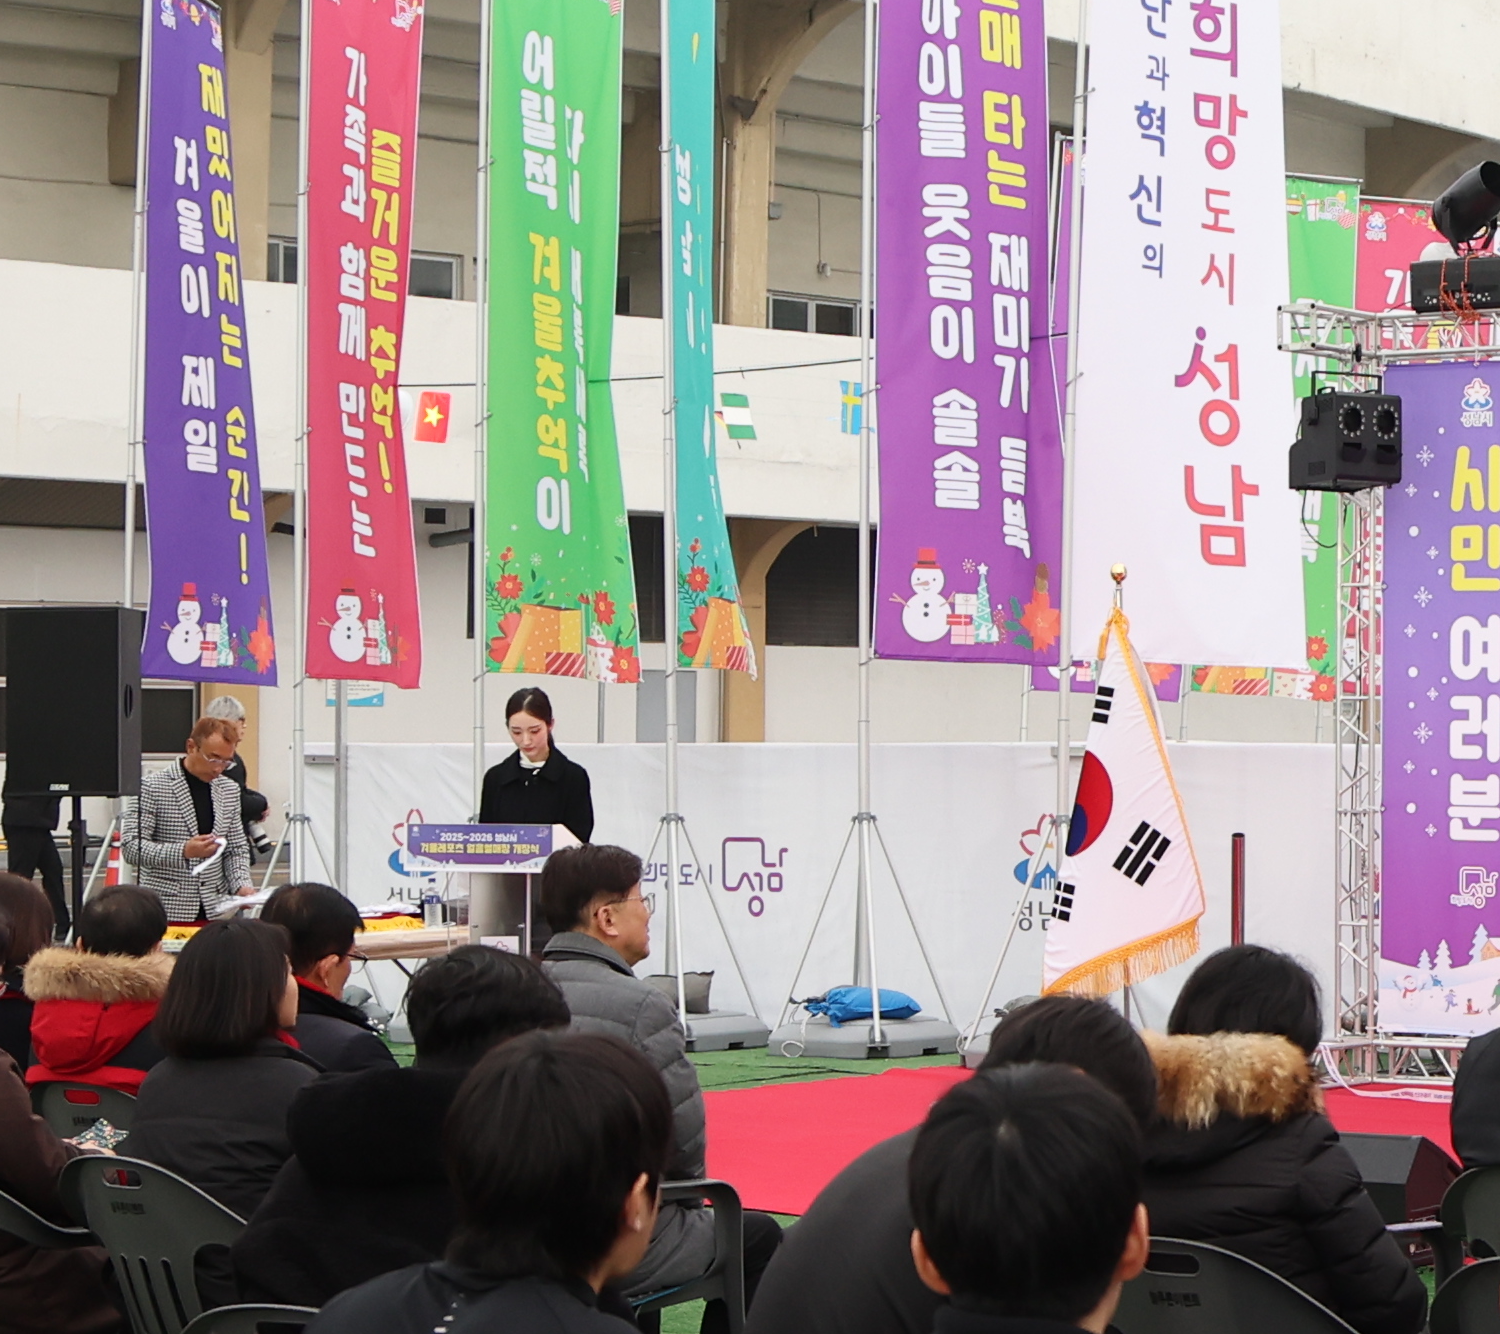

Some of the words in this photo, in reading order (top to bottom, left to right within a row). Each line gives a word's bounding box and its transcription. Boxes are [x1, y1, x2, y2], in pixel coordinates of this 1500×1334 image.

[341, 46, 368, 224] 가족과
[520, 29, 558, 212] 어릴적
[982, 89, 1027, 209] 타는
[173, 135, 211, 318] 겨울이
[198, 62, 242, 369] 재밌어지는
[338, 241, 367, 361] 함께
[369, 128, 402, 303] 즐거운
[921, 183, 975, 364] 웃음이
[181, 354, 218, 475] 제일
[932, 387, 980, 510] 솔솔
[1448, 614, 1500, 843] 여러분
[440, 833, 493, 842] 2025~2026
